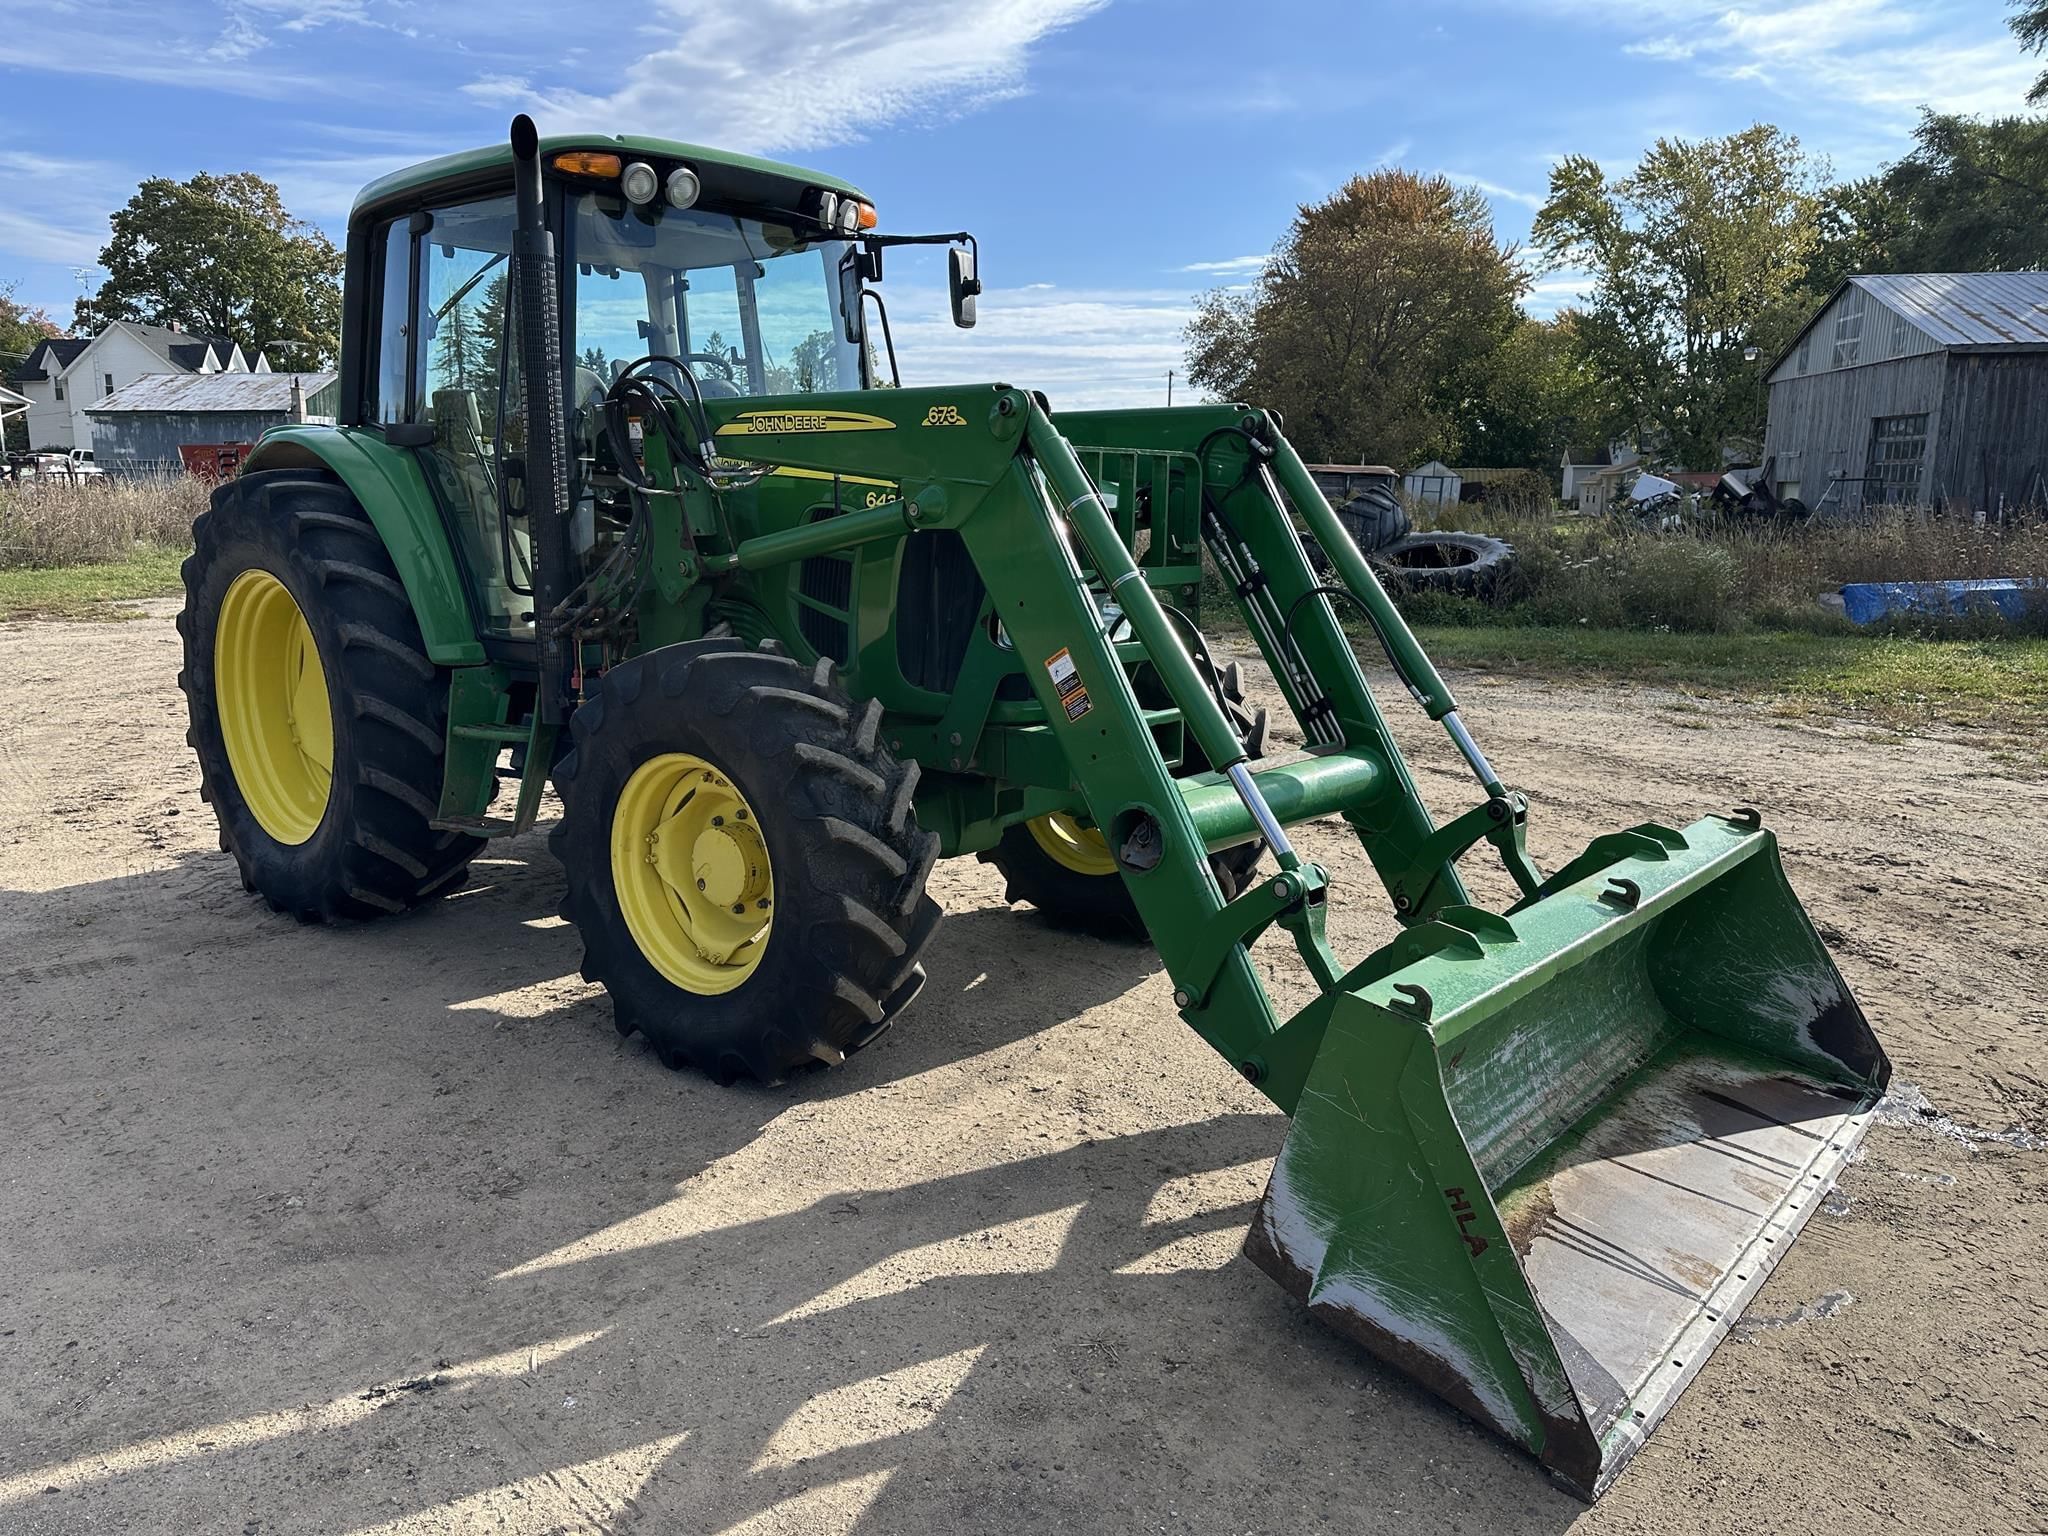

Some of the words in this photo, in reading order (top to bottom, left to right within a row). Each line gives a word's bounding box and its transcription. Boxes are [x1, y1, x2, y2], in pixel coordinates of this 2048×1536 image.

[748, 414, 783, 432] JOHN
[784, 413, 827, 431] DEERE
[928, 405, 957, 424] 673
[1444, 1187, 1489, 1258] HLA
